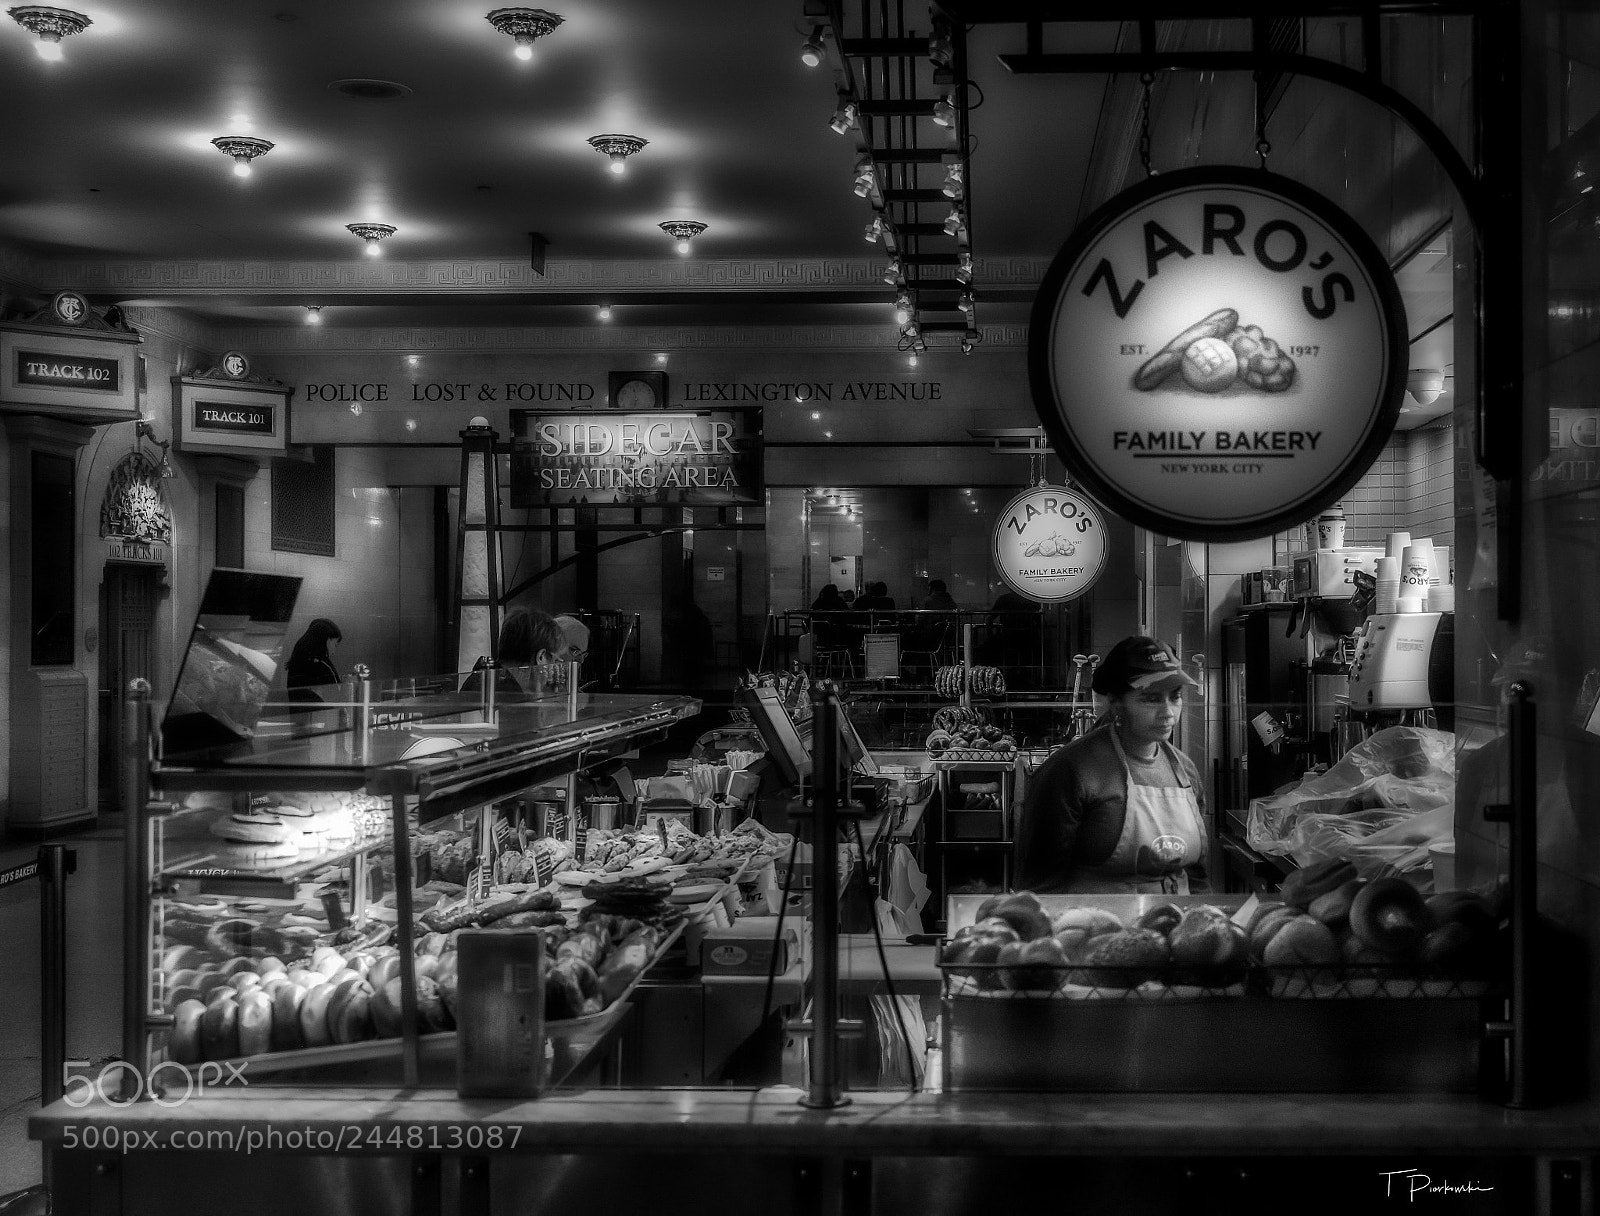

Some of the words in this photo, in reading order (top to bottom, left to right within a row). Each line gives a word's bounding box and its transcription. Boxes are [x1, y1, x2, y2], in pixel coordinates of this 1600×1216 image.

[1081, 204, 1355, 320] ZARO'S
[1120, 344, 1149, 355] EST.
[1289, 345, 1320, 356] 1927
[26, 362, 84, 380] TRACK
[86, 367, 110, 381] 102
[306, 384, 389, 401] POLICE
[412, 383, 471, 401] LOST
[477, 383, 498, 401] &
[505, 383, 594, 401] FOUND
[685, 383, 833, 401] LEXINGTON
[841, 383, 942, 401] AVENUE
[202, 409, 247, 424] TRACK
[248, 413, 265, 424] 101
[540, 421, 740, 457] SIDECAR
[1113, 431, 1205, 450] FAMILY
[1216, 431, 1322, 450] BAKERY
[1161, 464, 1188, 473] NEW
[1192, 464, 1229, 473] YORK
[1232, 464, 1263, 473] CITY
[540, 467, 659, 490] SEATING
[664, 466, 740, 491] AREA
[1007, 498, 1092, 535] ZARO'S
[122, 546, 152, 559] TRACKS
[1050, 567, 1084, 575] BAKERY
